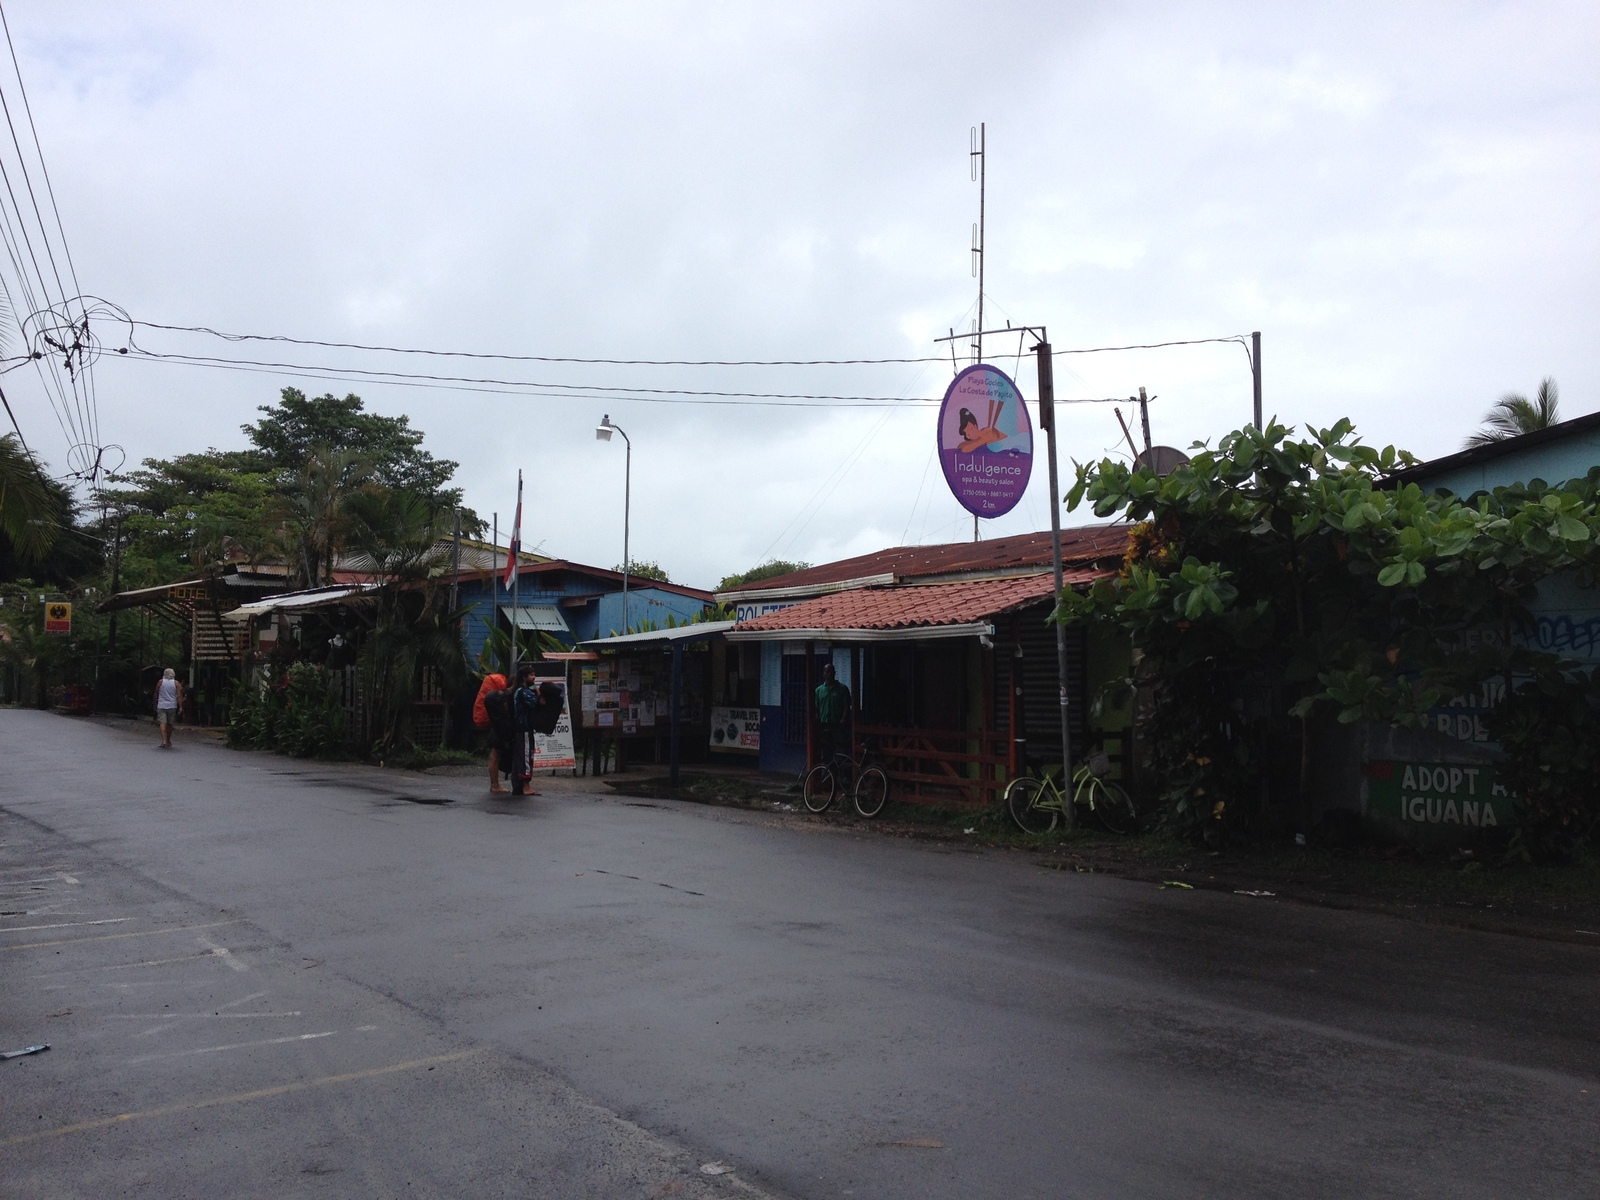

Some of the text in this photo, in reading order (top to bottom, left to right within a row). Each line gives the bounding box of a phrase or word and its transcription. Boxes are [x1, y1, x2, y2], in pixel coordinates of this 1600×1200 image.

[959, 386, 967, 394] La
[967, 387, 985, 395] Costa
[986, 389, 994, 397] de
[954, 453, 1021, 477] Indulgence
[962, 477, 972, 485] spa
[978, 477, 998, 486] beauty
[982, 500, 988, 508] 2
[167, 586, 210, 600] HOTEL
[1401, 764, 1480, 795] ADOPT
[1401, 796, 1498, 828] IGUANA
